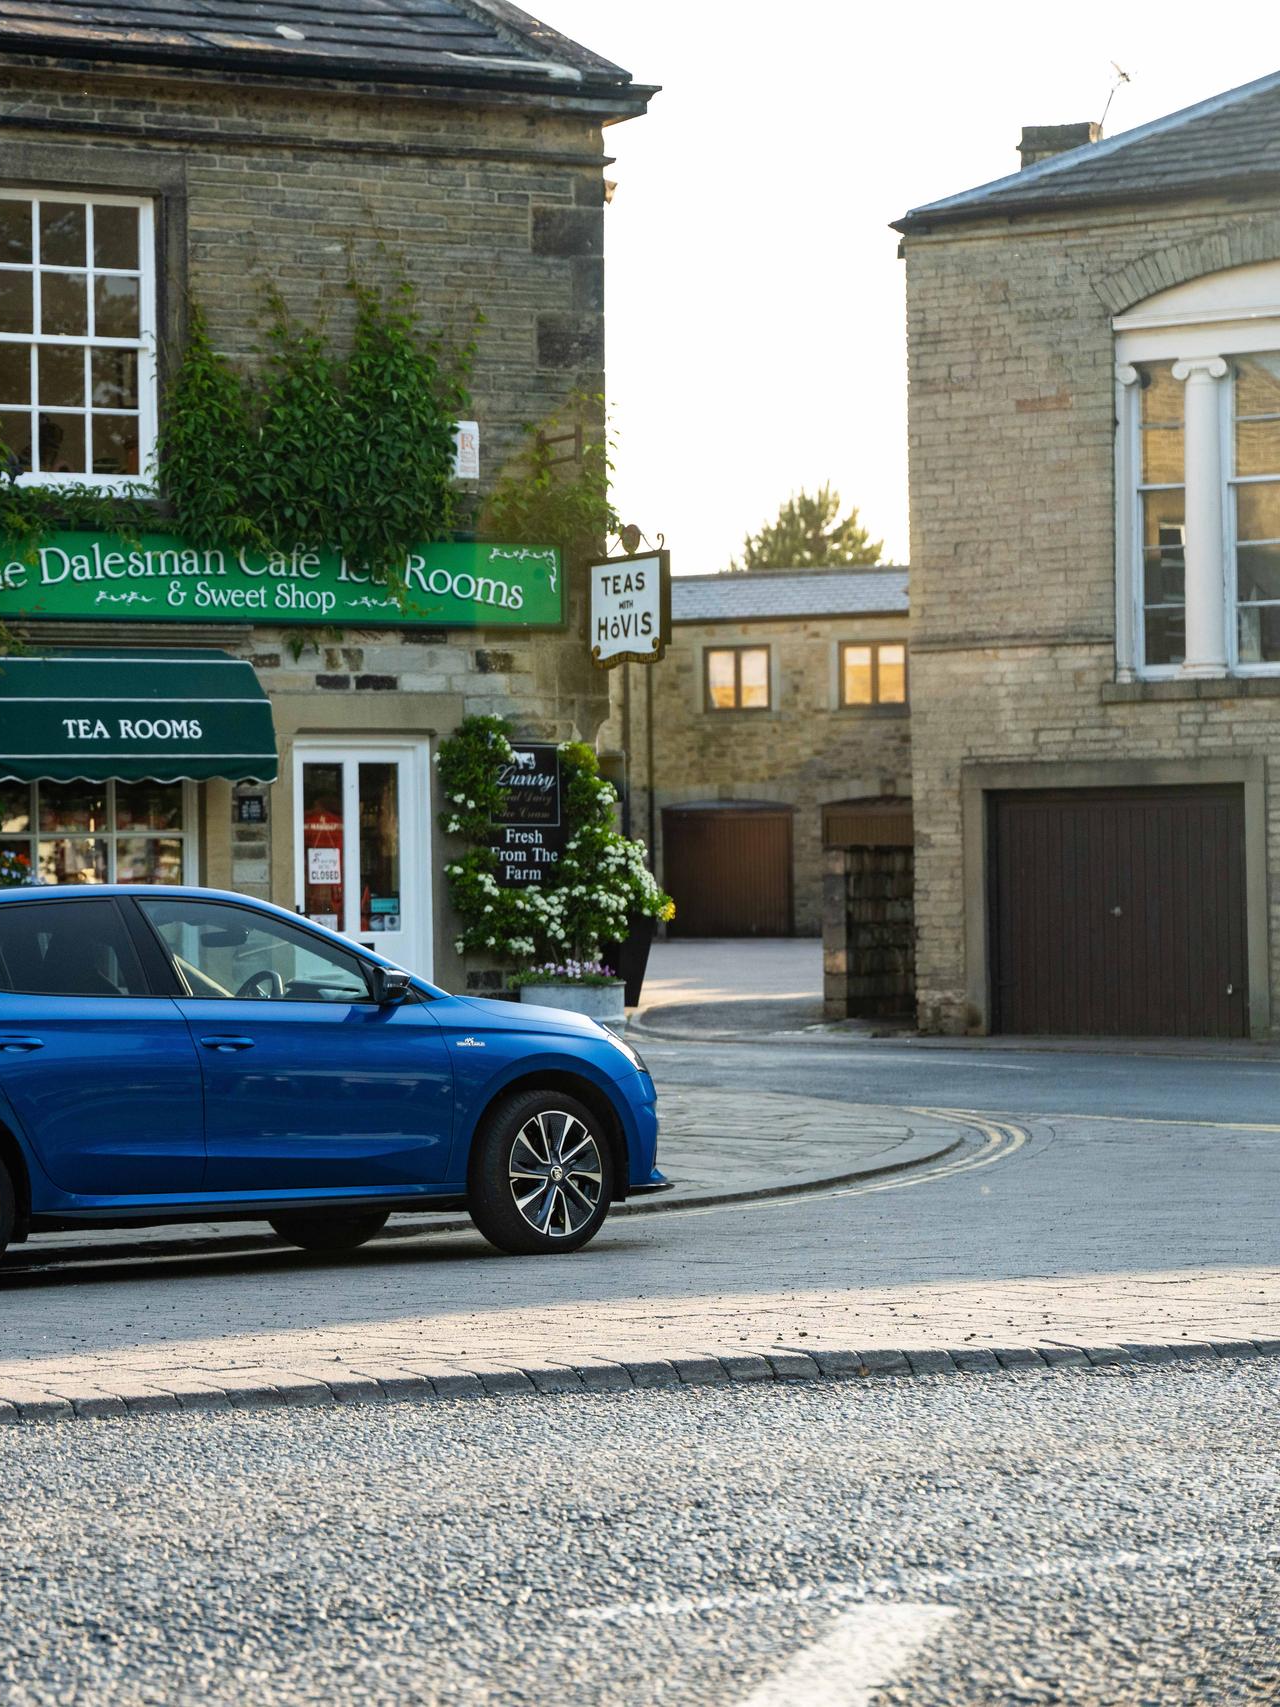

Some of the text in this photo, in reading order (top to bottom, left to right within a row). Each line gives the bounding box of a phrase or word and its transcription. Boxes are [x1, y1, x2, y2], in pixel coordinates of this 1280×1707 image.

[38, 542, 227, 585] Dalesman
[238, 542, 321, 578] Café
[404, 553, 524, 610] Rooms
[601, 571, 645, 596] TEAS
[167, 580, 337, 615] & Sweet Shop
[618, 600, 634, 610] WITH
[62, 719, 203, 739] TEA ROOMS
[495, 764, 556, 792] Luxury
[505, 828, 543, 844] Fresh
[532, 847, 558, 862] The
[311, 870, 339, 880] CLOSED
[505, 865, 542, 880] Farm
